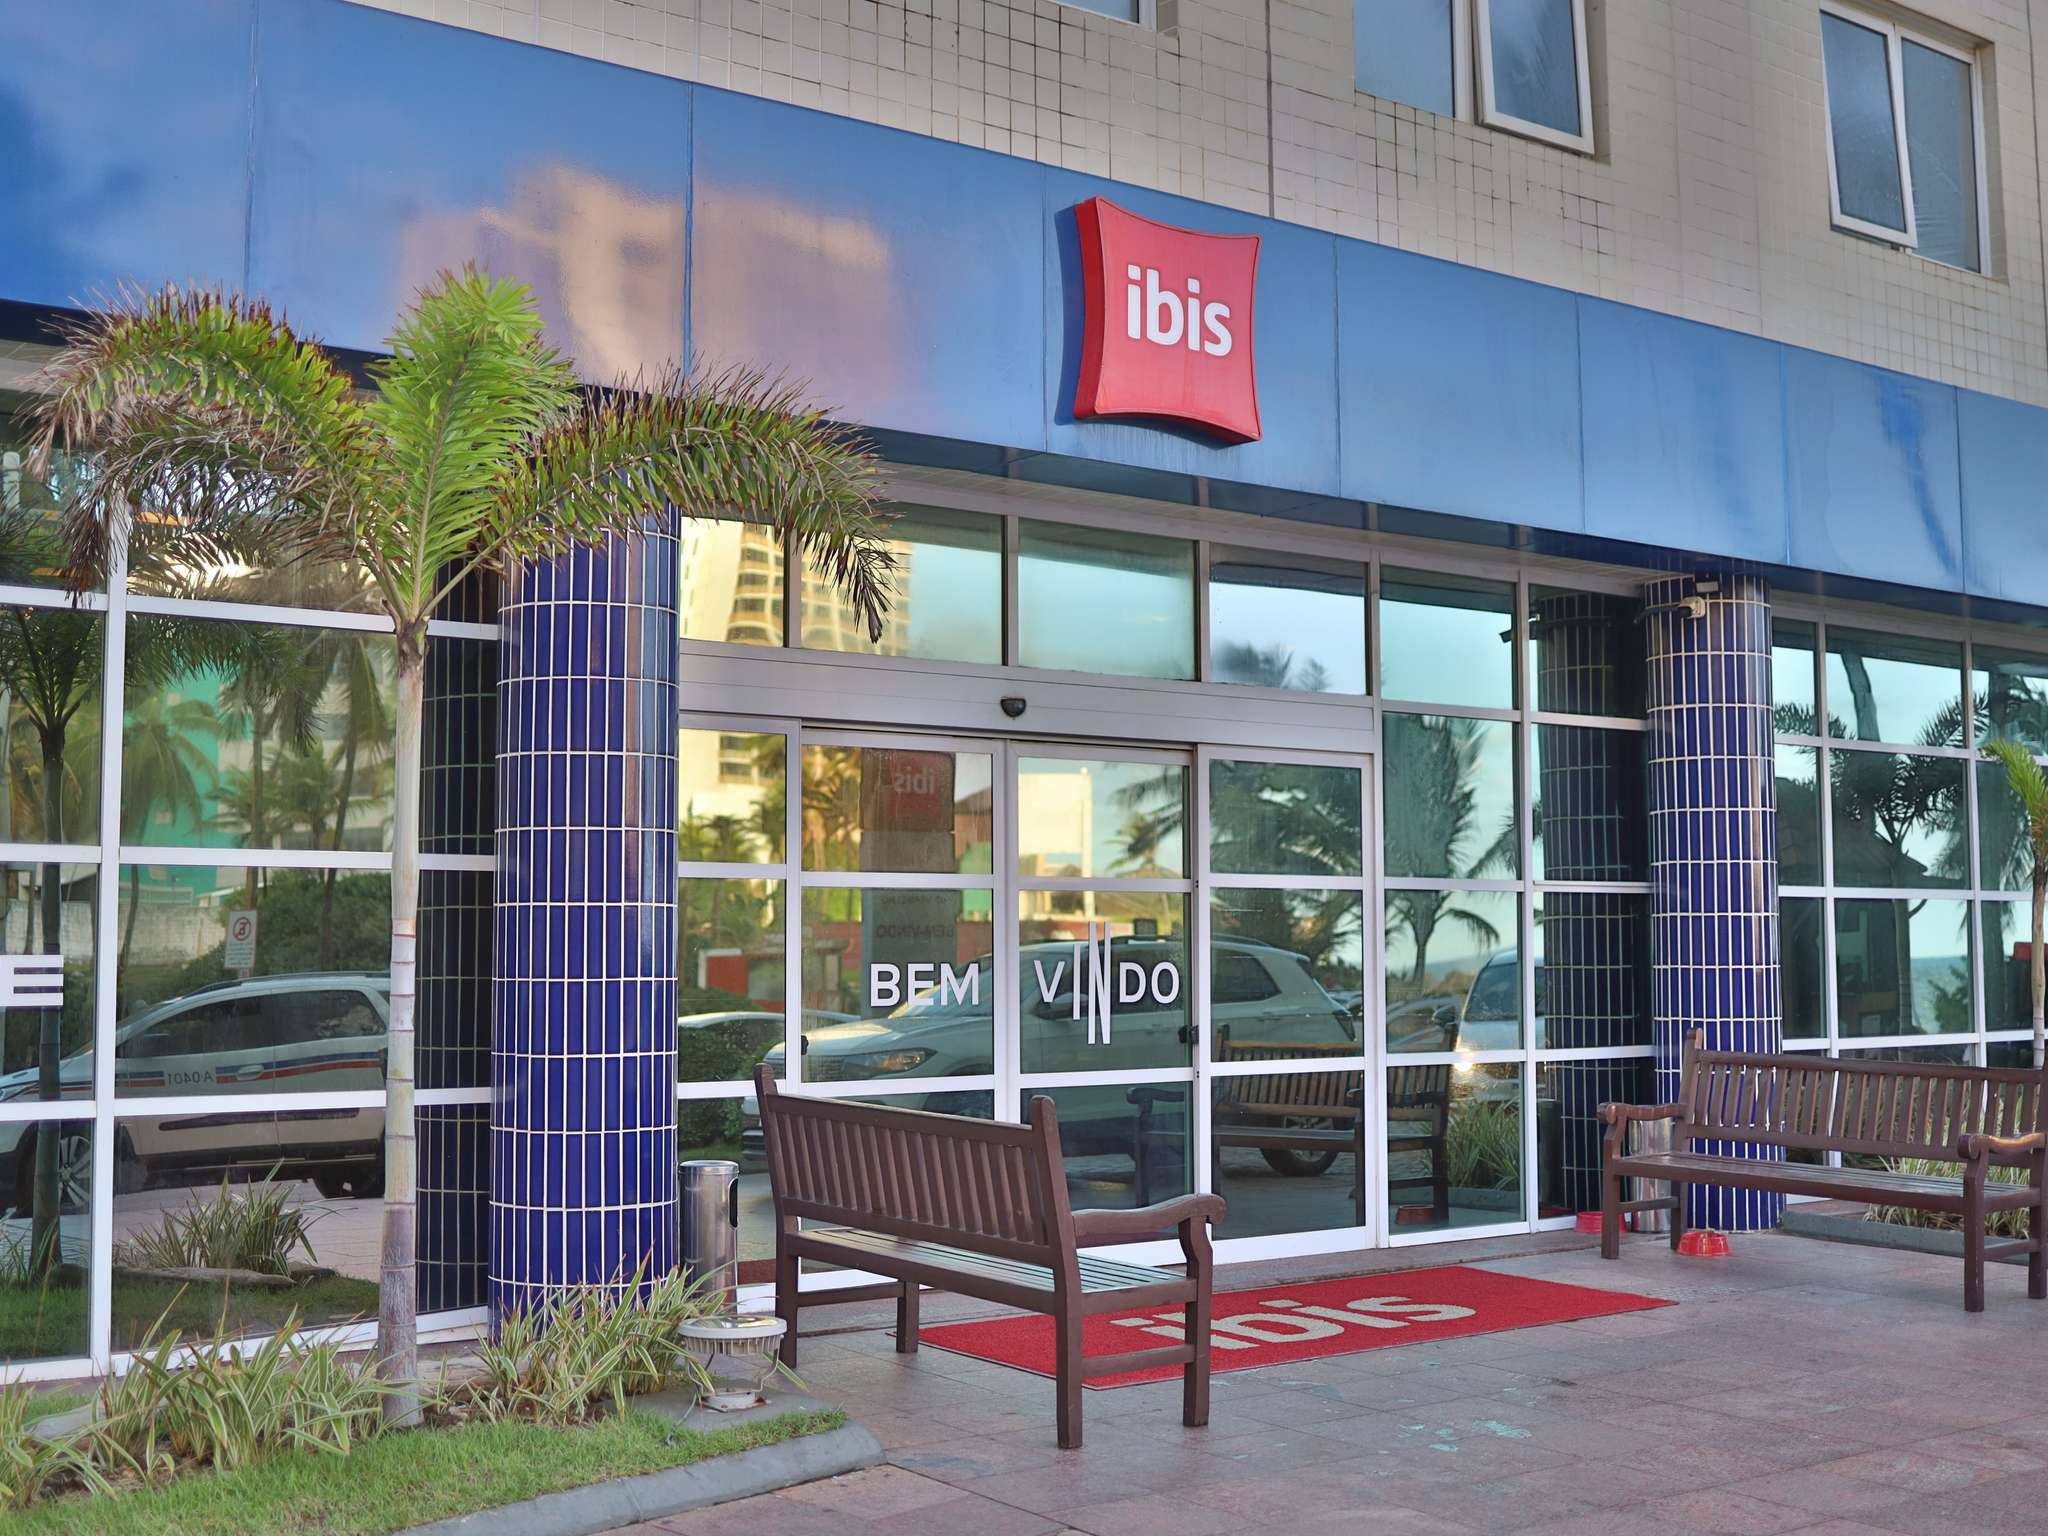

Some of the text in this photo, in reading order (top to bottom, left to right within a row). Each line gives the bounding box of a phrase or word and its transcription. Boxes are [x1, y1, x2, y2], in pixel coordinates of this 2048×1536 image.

[1127, 264, 1233, 356] ibis
[870, 921, 1180, 1044] BEM VINDO
[1110, 1296, 1477, 1350] ibis
